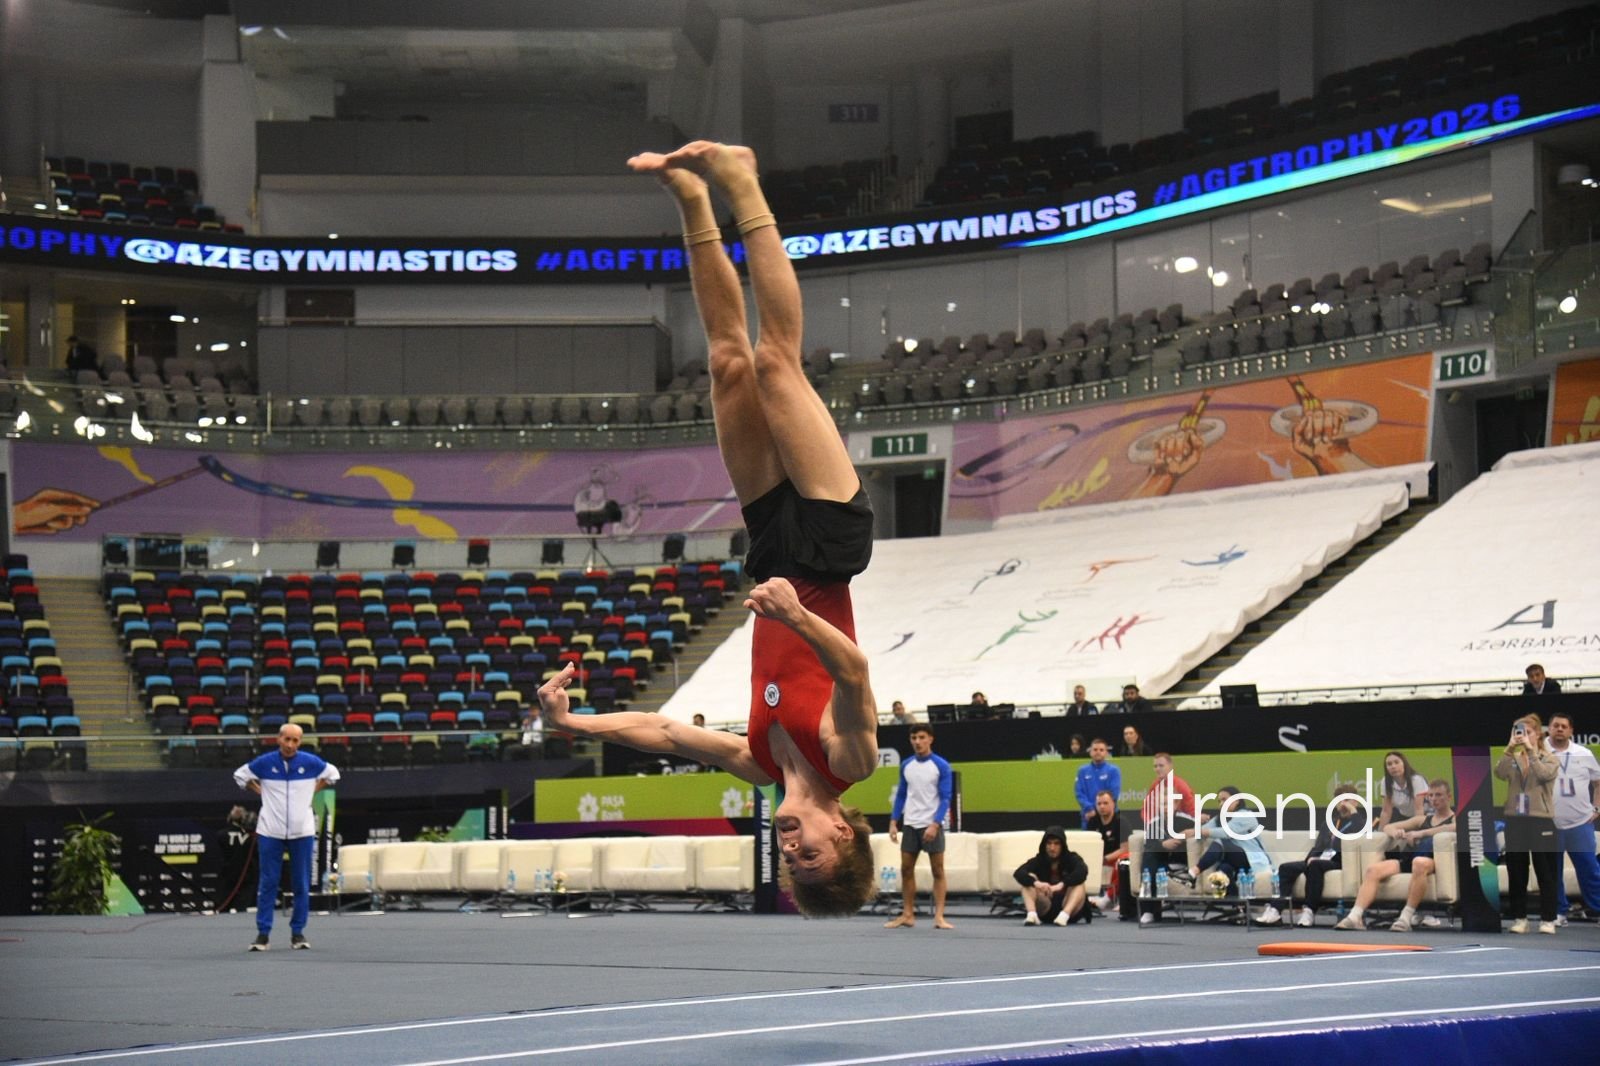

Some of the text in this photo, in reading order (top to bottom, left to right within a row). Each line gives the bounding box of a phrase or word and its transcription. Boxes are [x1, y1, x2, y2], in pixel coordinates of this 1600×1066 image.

[1154, 94, 1521, 206] #AGFTROPHY2026
[0, 225, 123, 258] OPHY
[124, 237, 518, 273] @AZEGYMNASTICS
[782, 190, 1137, 260] @AZEGYMNASTICS
[1444, 353, 1482, 377] 110
[886, 436, 914, 454] 111
[761, 829, 772, 883] TRAMPOLINE
[1468, 810, 1484, 868] TUMBLING
